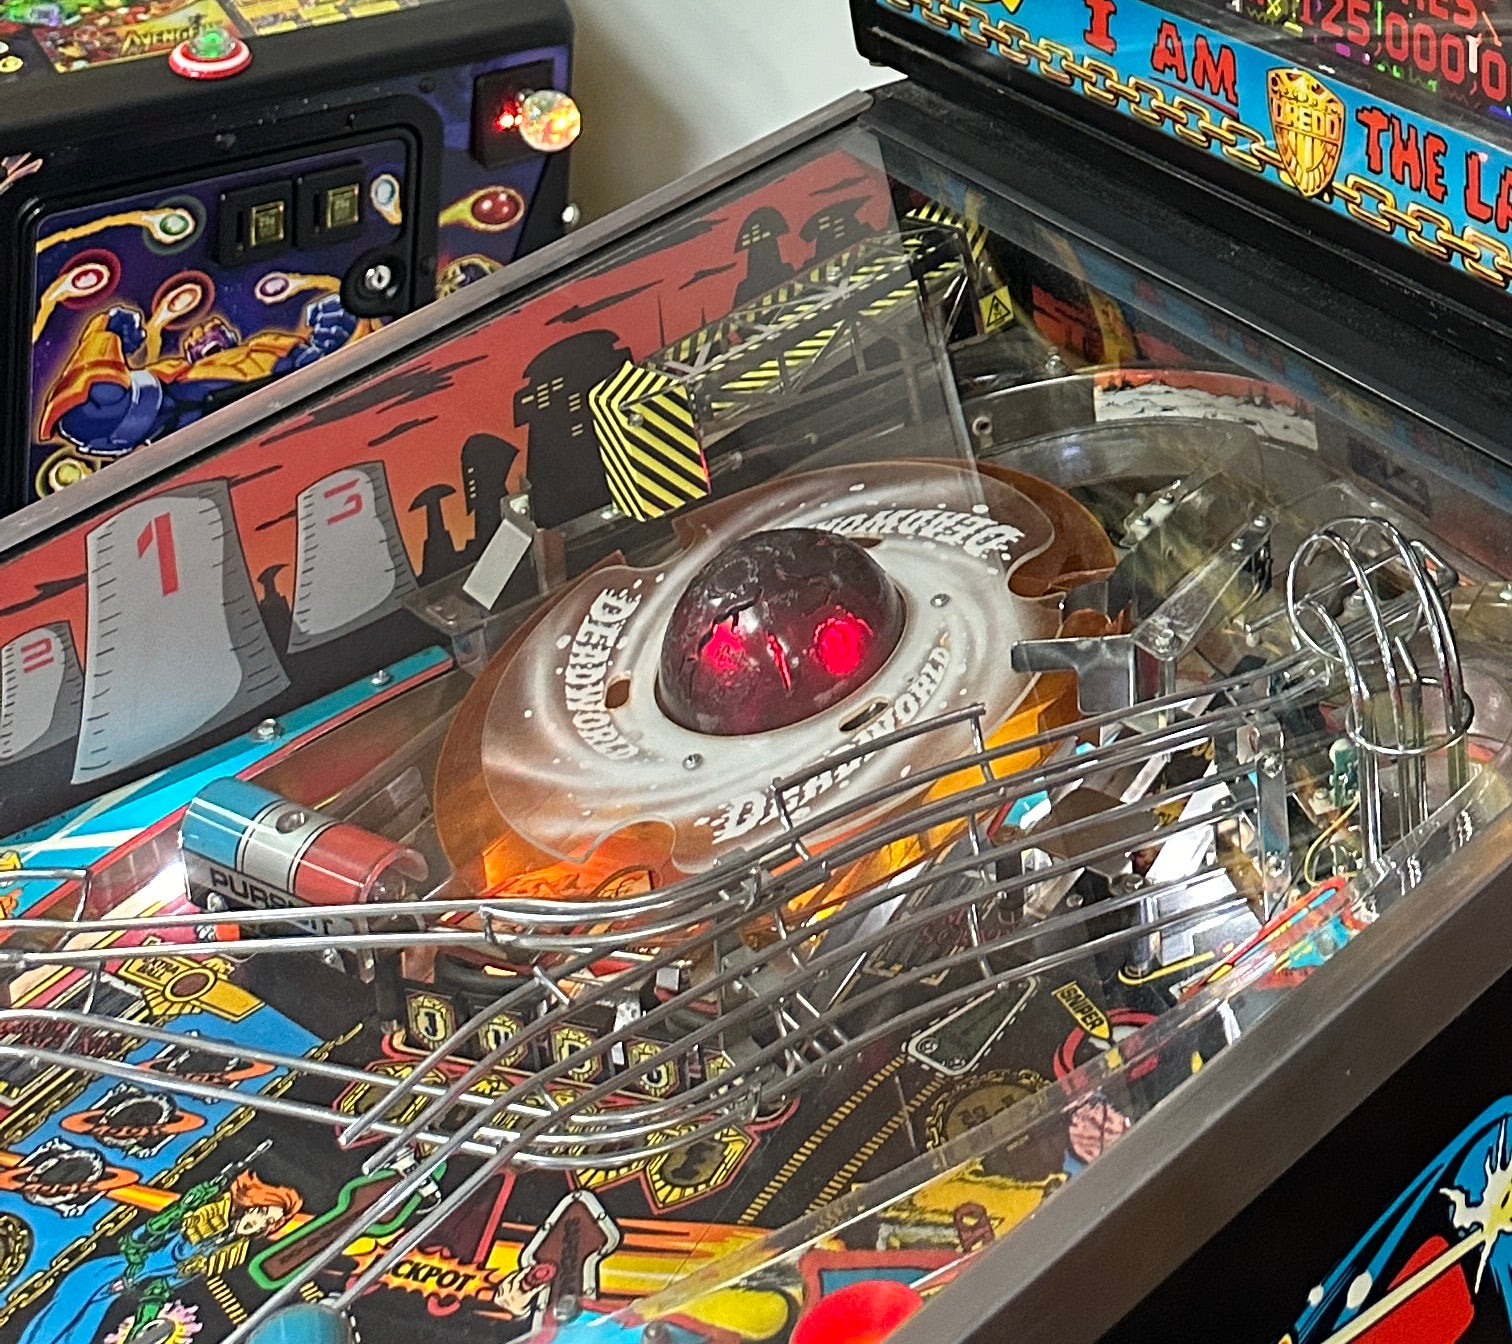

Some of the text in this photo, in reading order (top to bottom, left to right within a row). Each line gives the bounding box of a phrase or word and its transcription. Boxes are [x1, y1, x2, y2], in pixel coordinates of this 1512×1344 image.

[1151, 20, 1239, 105] AM
[1357, 107, 1448, 203] THE
[1273, 98, 1341, 142] DREDD
[137, 512, 179, 597] 1
[1059, 986, 1105, 1031] SNIPER
